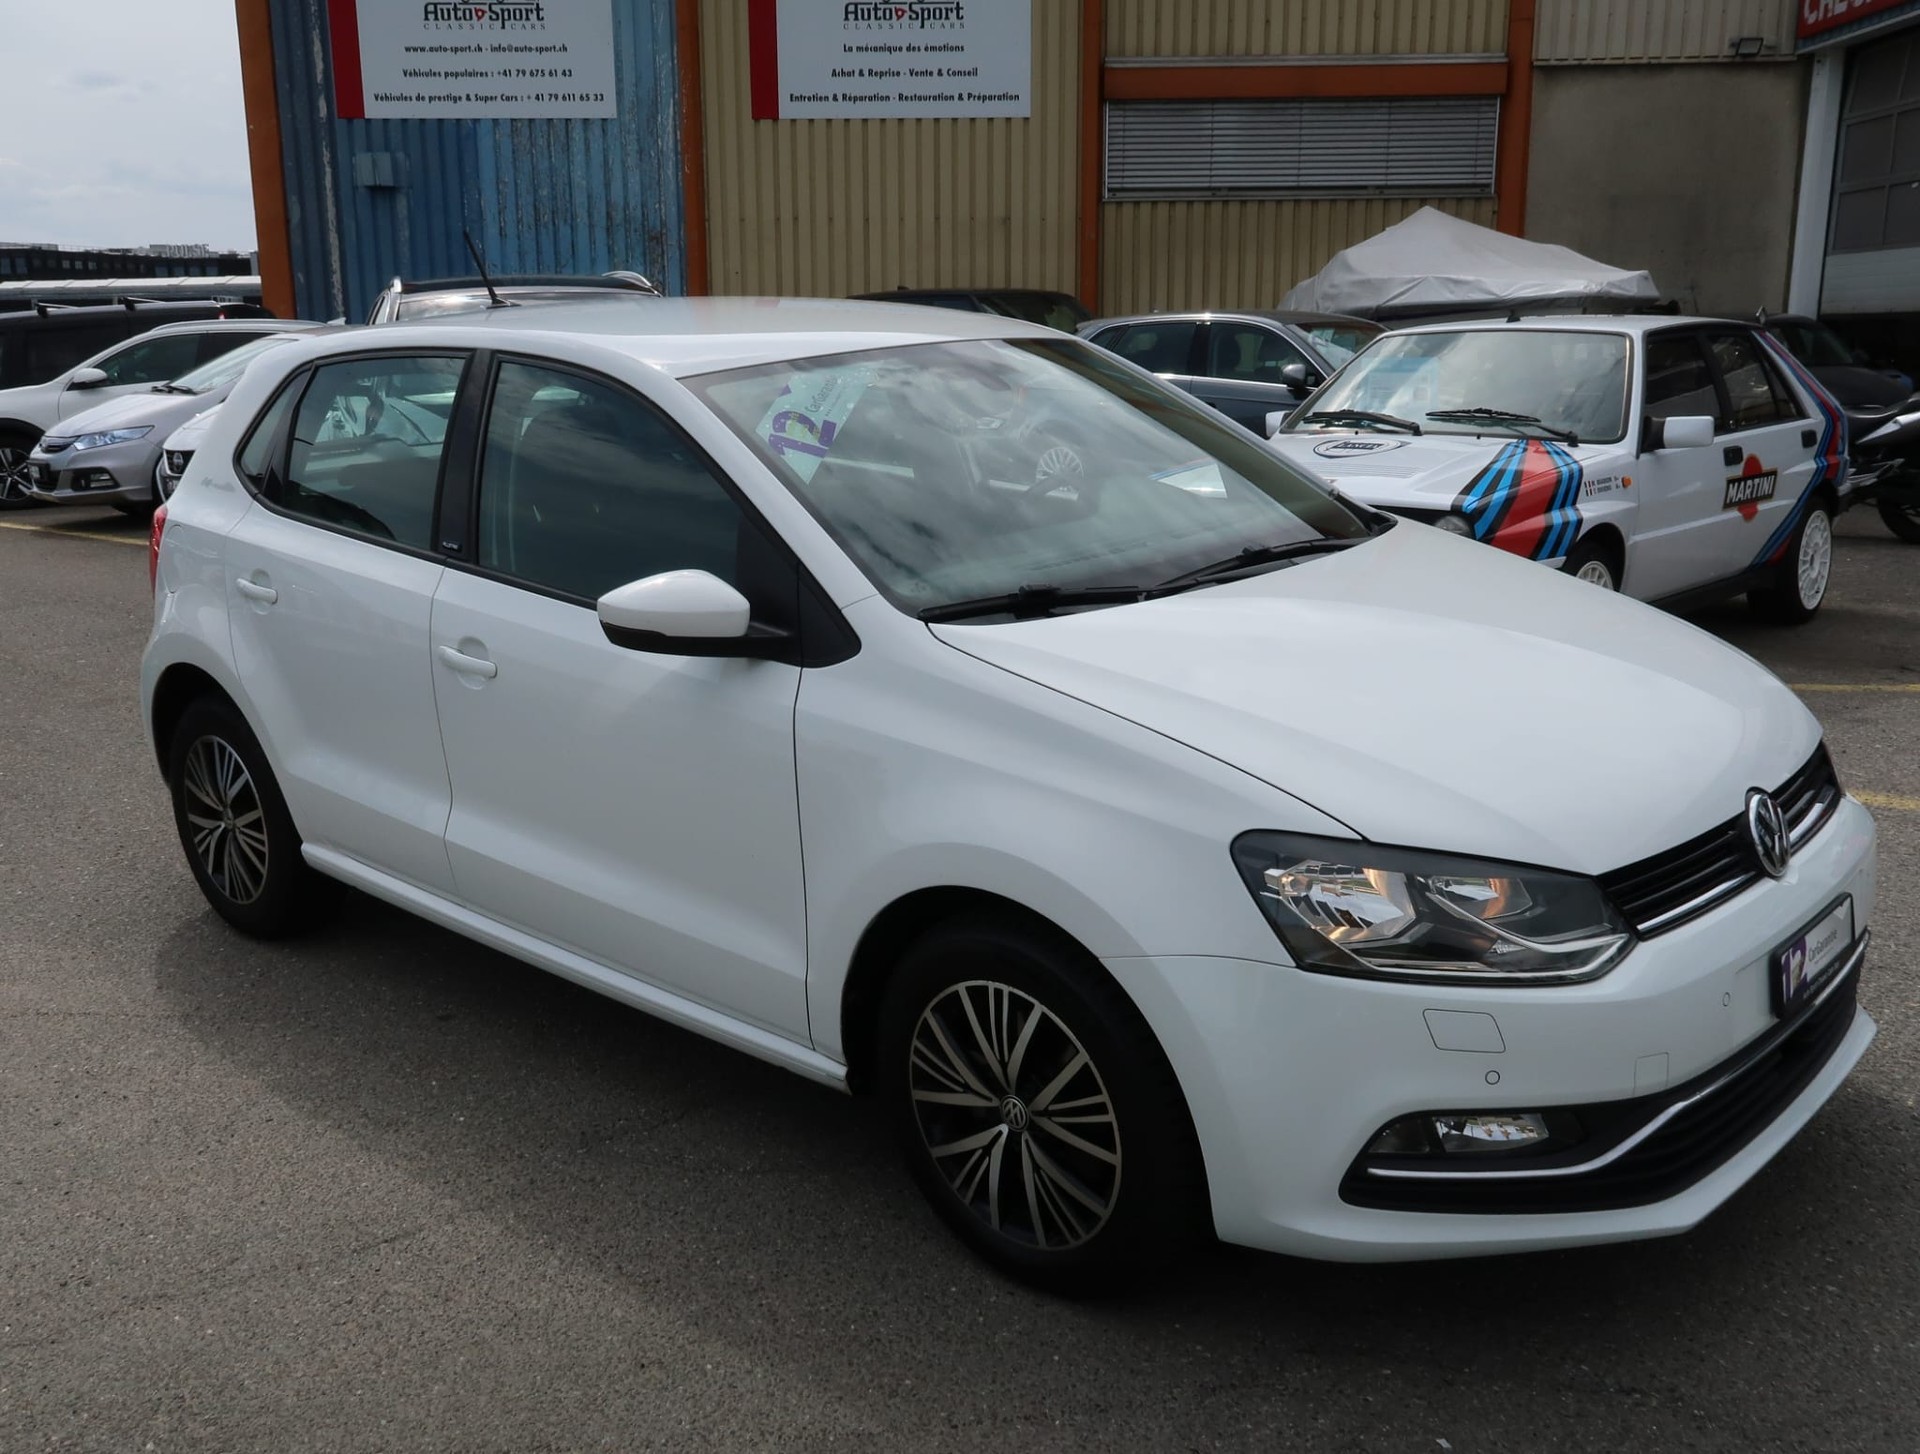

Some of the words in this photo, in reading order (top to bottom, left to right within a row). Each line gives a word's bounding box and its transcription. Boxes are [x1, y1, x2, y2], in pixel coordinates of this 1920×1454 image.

[423, 2, 473, 21] Auto
[488, 2, 544, 30] Sport
[843, 2, 893, 21] Auto
[908, 2, 964, 29] Sport
[843, 22, 914, 30] CLASSIC
[404, 43, 483, 55] www.auto-sport.ch
[490, 43, 568, 56] info@auto-sport.ch
[843, 43, 854, 53] La
[855, 42, 904, 55] mécanique
[905, 42, 922, 53] des
[923, 42, 965, 53] émotions
[402, 68, 442, 78] Véhicules
[443, 68, 489, 80] populaires
[497, 68, 512, 78] +41
[515, 68, 527, 78] 79
[529, 68, 546, 78] 675
[548, 68, 558, 78] 61
[561, 68, 573, 78] 43
[831, 67, 856, 78] Achat
[858, 68, 865, 78] &
[867, 67, 901, 80] Reprise
[908, 68, 934, 78] Vente
[936, 68, 944, 77] &
[946, 66, 978, 77] Conseil
[373, 92, 413, 102] Véhicules
[415, 92, 426, 102] de
[428, 92, 463, 104] prestige
[465, 93, 472, 102] &
[474, 93, 498, 104] Super
[500, 93, 519, 102] Cars
[534, 93, 545, 102] 41
[547, 93, 559, 102] 79
[561, 92, 576, 102] 611
[579, 93, 591, 102] 65
[593, 93, 604, 102] 33
[789, 92, 830, 103] Entretien
[831, 93, 839, 102] &
[841, 92, 891, 105] Réparation
[898, 92, 955, 102] Restauration
[957, 92, 965, 102] &
[967, 91, 1020, 104] Préparation
[768, 410, 837, 459] 12
[1726, 475, 1775, 504] MARTINI
[1782, 936, 1807, 1002] 12
